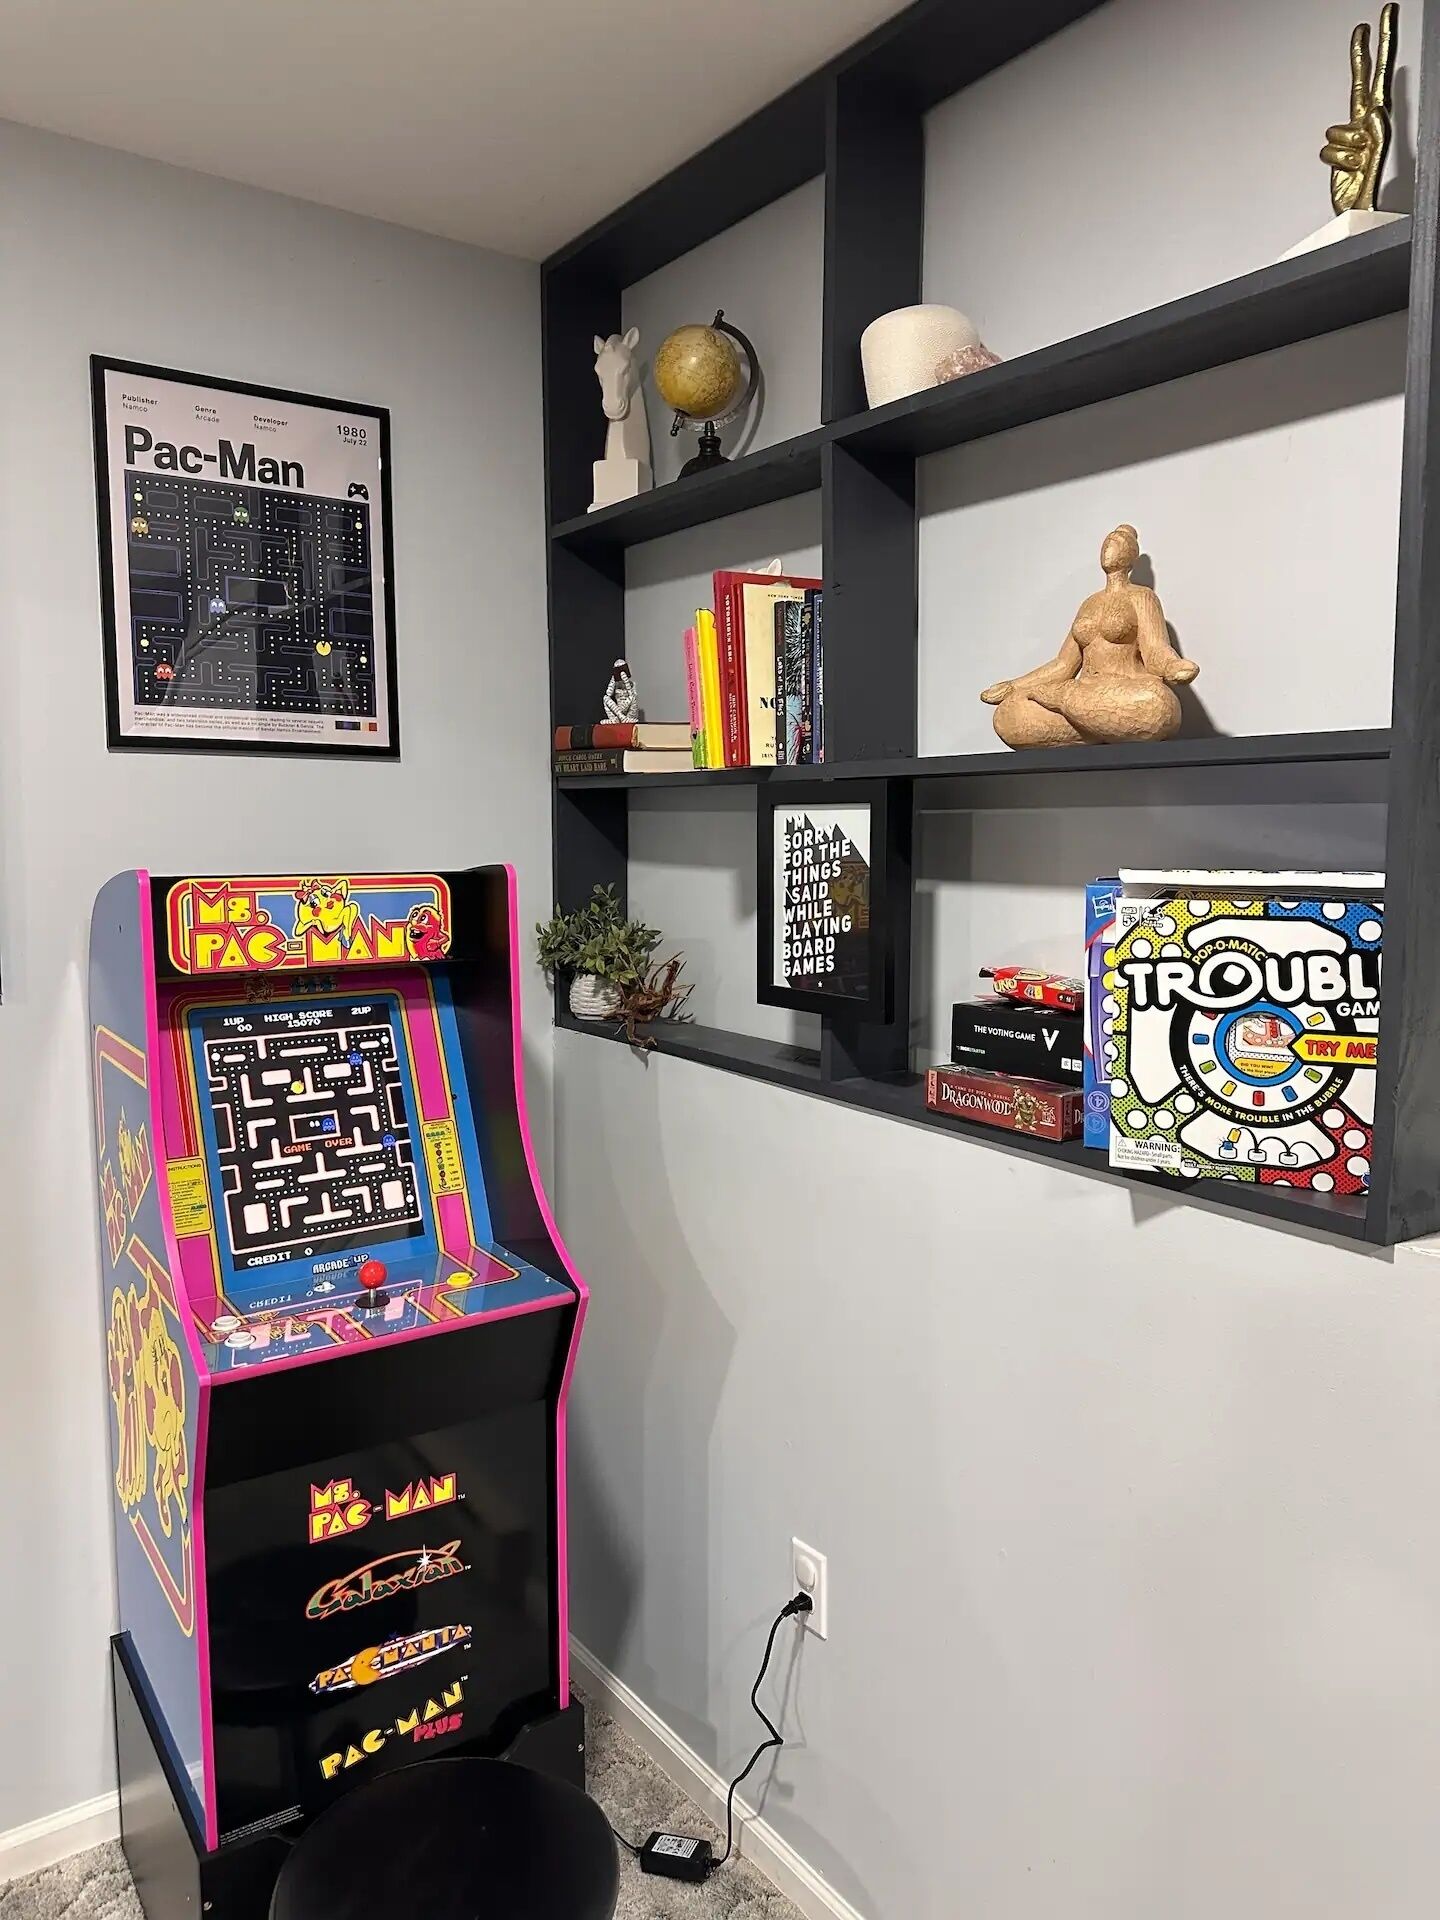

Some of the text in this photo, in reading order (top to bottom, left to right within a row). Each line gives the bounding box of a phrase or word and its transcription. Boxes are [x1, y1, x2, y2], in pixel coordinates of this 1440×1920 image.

[122, 393, 158, 405] Publisher
[122, 402, 148, 412] Namco
[195, 405, 217, 414] Genre
[196, 414, 220, 423] Arcade
[253, 415, 288, 427] Developer
[336, 424, 367, 439] 1980
[343, 436, 358, 446] July
[124, 424, 304, 489] Pac-Man
[724, 594, 732, 643] NOTORIOUS
[784, 812, 806, 834] I'M
[784, 823, 836, 852] SORRY
[784, 839, 851, 870] FOR THE
[782, 860, 842, 888] THINGS
[792, 880, 829, 904] SAID
[193, 885, 270, 925] MS.
[783, 899, 833, 923] WHILE
[782, 914, 852, 941] PLAYING
[191, 917, 409, 973] PAC-MAN
[782, 936, 836, 960] BOARD
[1191, 939, 1268, 965] POP-O-MATIC
[782, 954, 836, 978] GAMES
[994, 980, 1018, 992] UNO
[1124, 951, 1382, 1008] TROUBL
[223, 1006, 372, 1026] 1UP HIGH SCORE 2UP
[1336, 1001, 1381, 1017] GAM
[237, 1018, 321, 1032] 00 15070
[974, 1024, 1036, 1042] THE VOTING GAME
[1042, 1028, 1060, 1052] V
[1305, 1040, 1377, 1059] TRY ME
[942, 1082, 1012, 1116] DRAGONWOOD
[1179, 1064, 1344, 1124] THERE'S MORE TROUBLE IN THE BUBBLE
[284, 1137, 352, 1154] GAME OVER
[1135, 1140, 1180, 1153] WARNING:
[247, 1248, 313, 1266] CREDIT 0
[311, 1480, 360, 1510] MS.
[309, 1473, 456, 1544] PAC-MAN
[319, 1680, 464, 1780] PAC-MAN
[414, 1712, 464, 1743] PLUS
